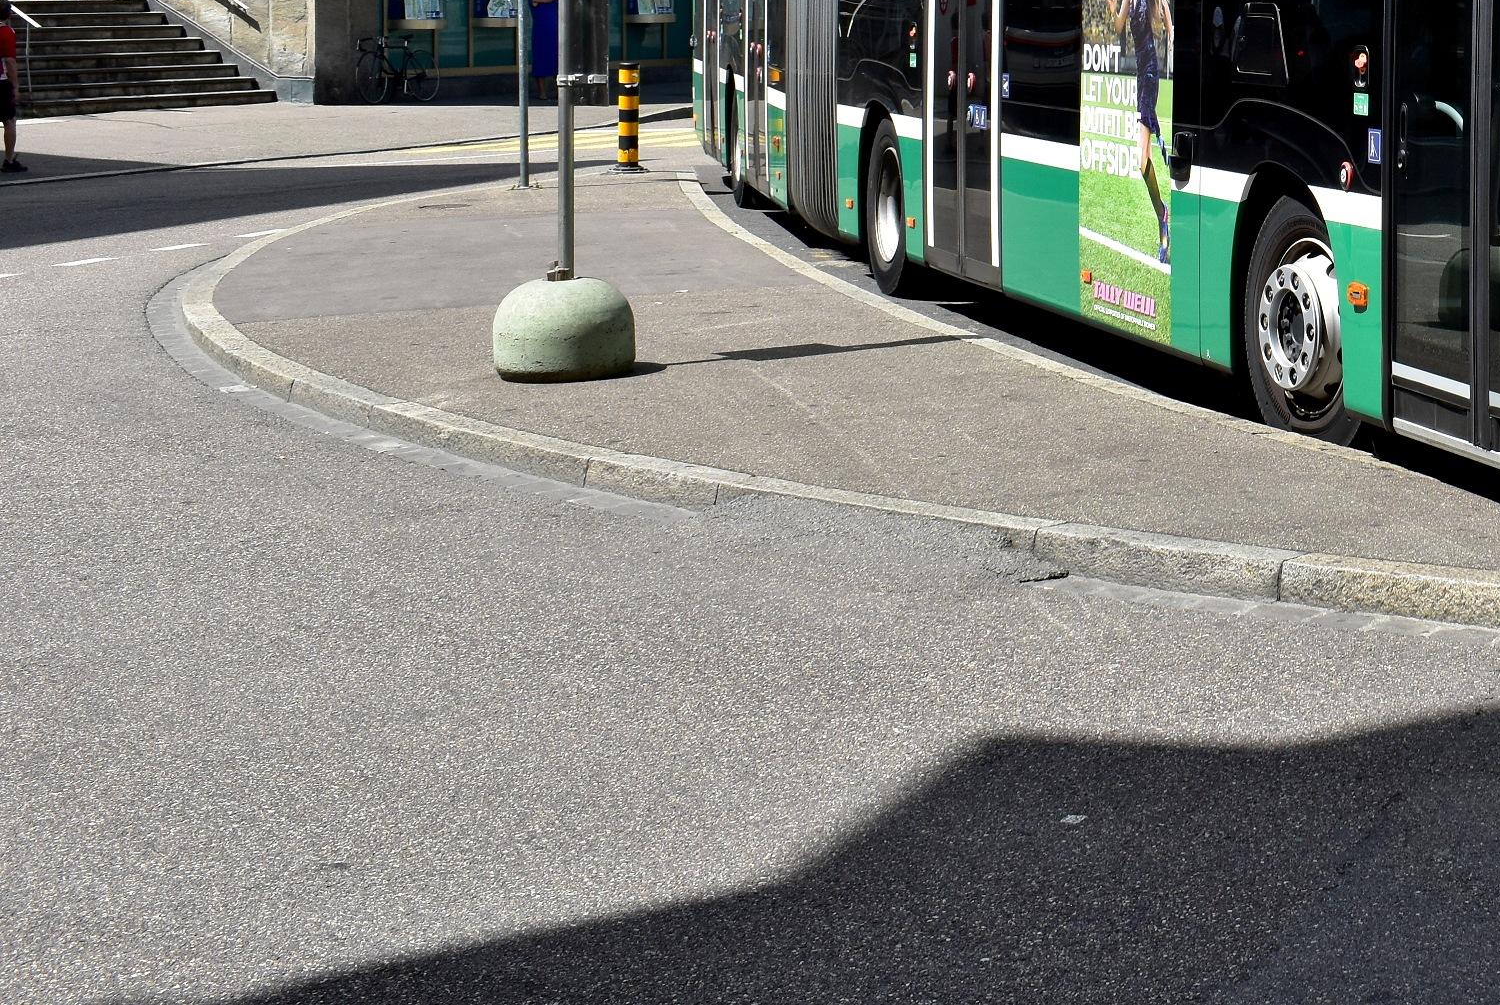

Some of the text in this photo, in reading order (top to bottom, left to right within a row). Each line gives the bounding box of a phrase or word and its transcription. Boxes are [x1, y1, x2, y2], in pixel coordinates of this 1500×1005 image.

[1083, 43, 1121, 73] DON'T
[1083, 75, 1138, 108] LET YOUR
[1083, 104, 1142, 142] OUTFIT BE
[1094, 281, 1122, 305] TALLY
